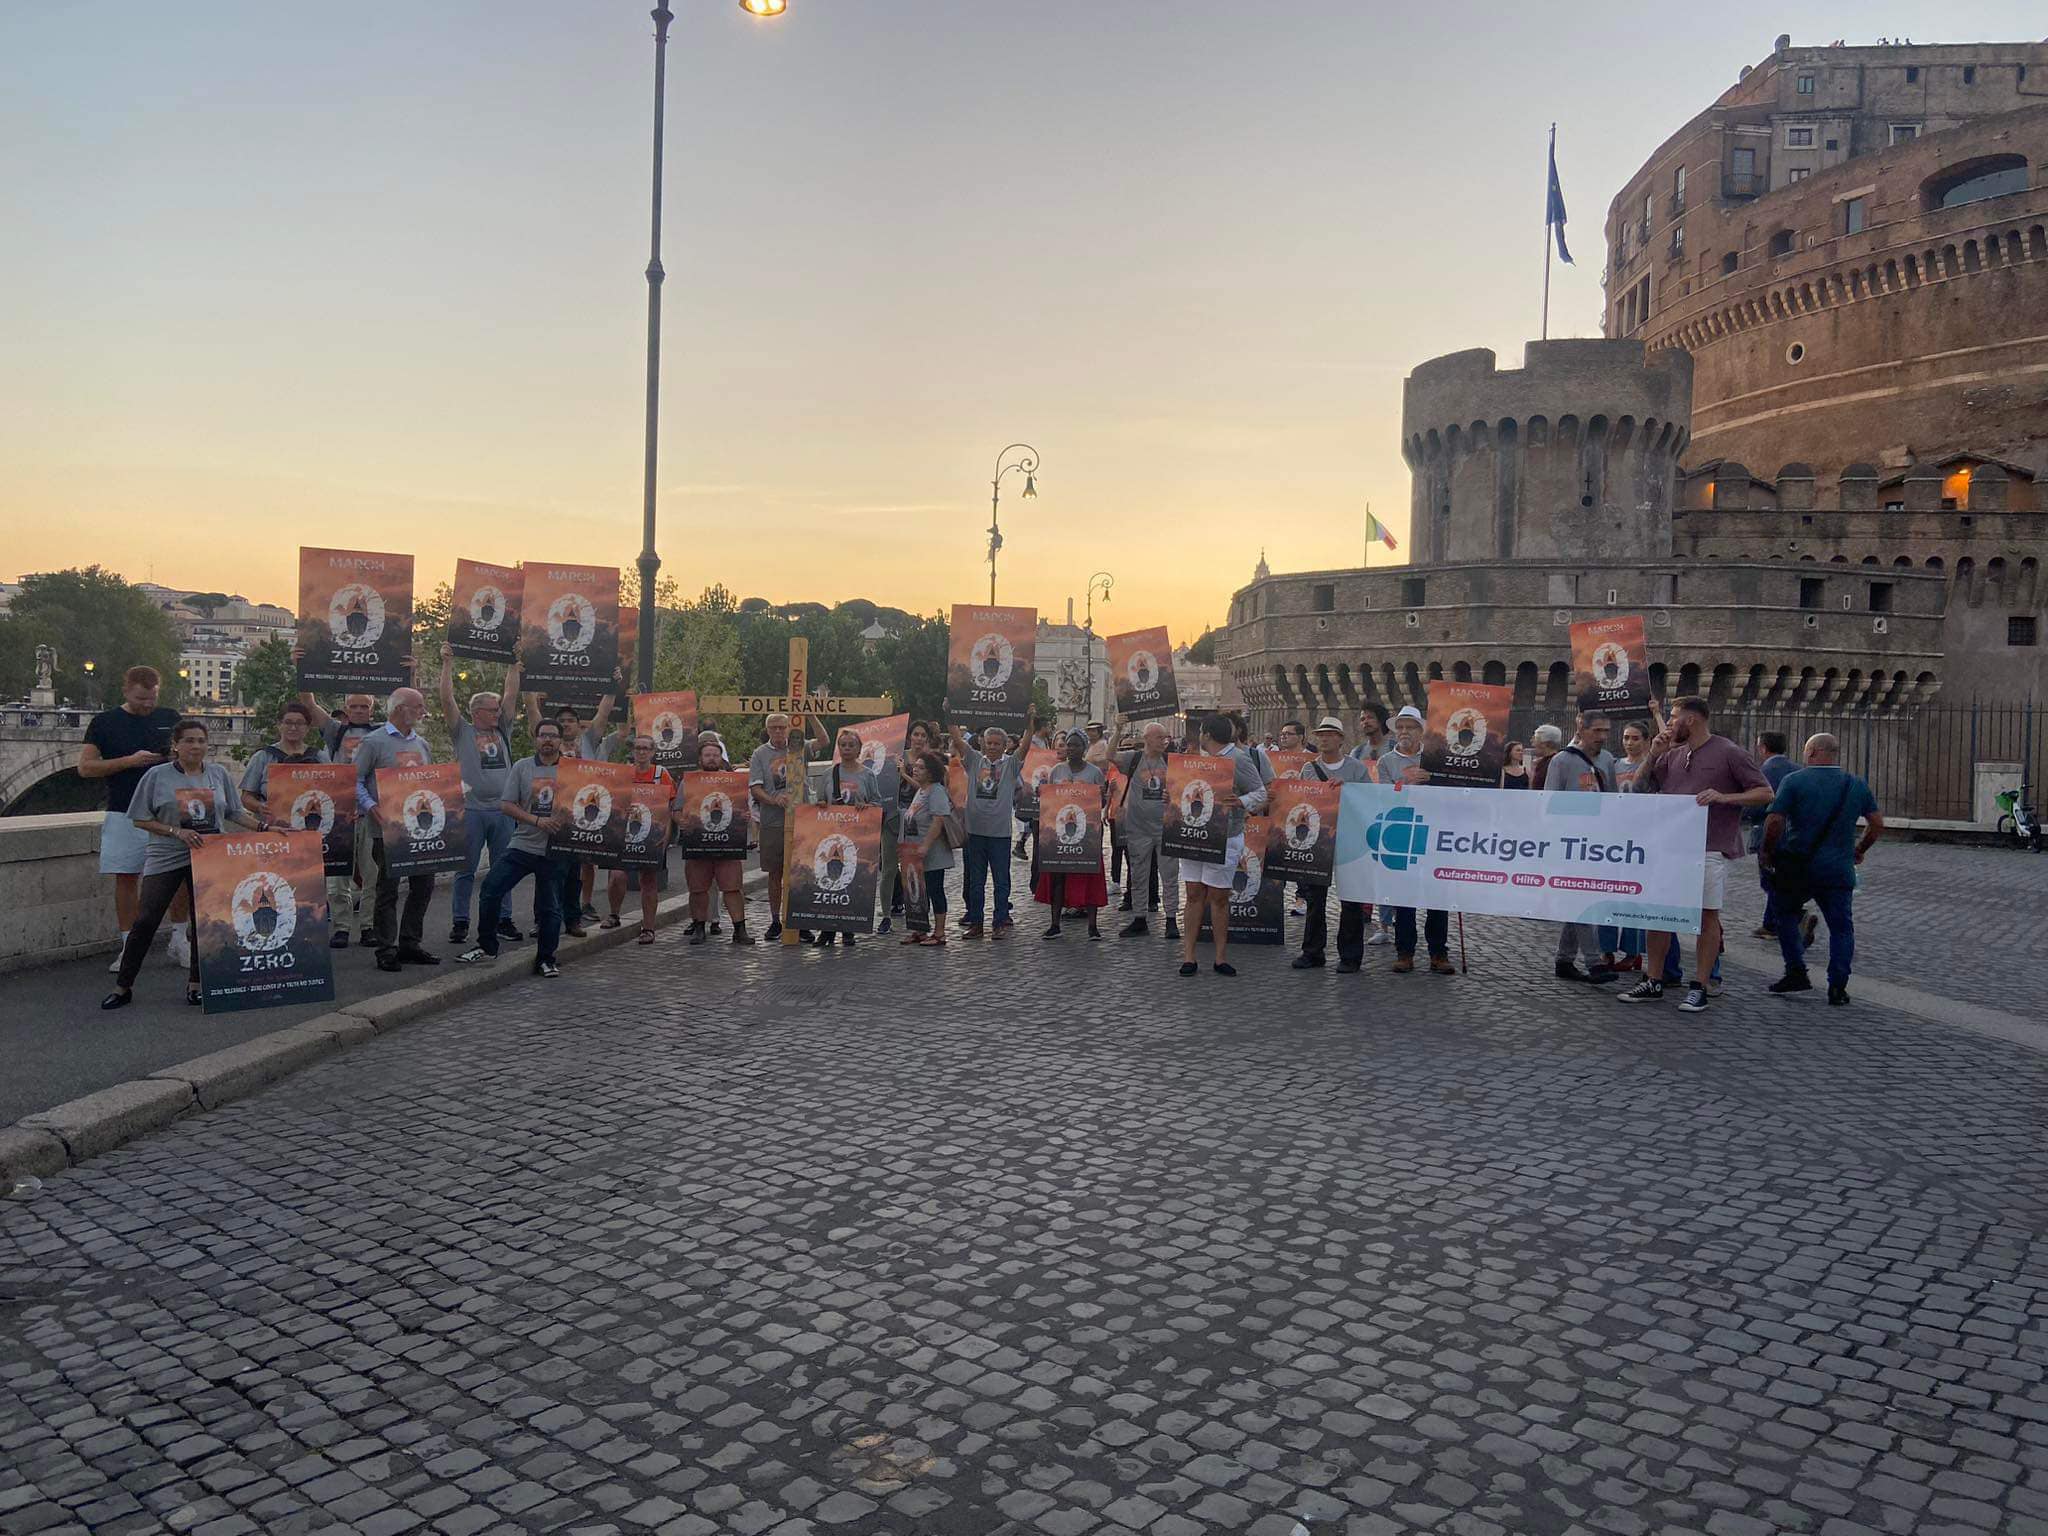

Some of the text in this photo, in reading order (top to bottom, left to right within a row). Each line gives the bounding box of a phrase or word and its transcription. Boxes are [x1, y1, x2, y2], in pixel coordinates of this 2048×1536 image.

[329, 557, 384, 571] MARCH
[548, 570, 596, 583] MARCH
[468, 630, 499, 642] ZERO
[331, 650, 379, 664] ZERO
[549, 653, 591, 667] ZERO
[970, 690, 1007, 702] ZERO
[1134, 691, 1160, 703] ZERO
[1450, 688, 1490, 700] MARCH
[1598, 689, 1630, 701] ZERO
[739, 698, 847, 713] TOLERANCE
[656, 750, 682, 760] ZERO
[1184, 760, 1216, 771] MARCH
[1445, 756, 1480, 768] ZERO
[292, 769, 336, 780] MARCH
[398, 770, 440, 780] MARCH
[1288, 784, 1324, 794] MARCH
[816, 811, 860, 824] MARCH
[571, 830, 604, 844] ZERO
[701, 832, 728, 842] ZERO
[1180, 826, 1208, 840] ZERO
[227, 842, 290, 856] MARCH
[409, 840, 446, 852] ZERO
[626, 844, 646, 854] ERO
[1056, 846, 1084, 854] ZERO
[1436, 831, 1646, 865] Eckiger Tisch
[1284, 850, 1314, 862] ZERO
[1438, 870, 1637, 894] Aufarbeitung Hilfe Entschädigung
[812, 892, 850, 906] ZERO
[1230, 906, 1258, 918] ERO
[1612, 912, 1690, 924] www.eckiger-tisch.de
[240, 952, 296, 972] ZERO
